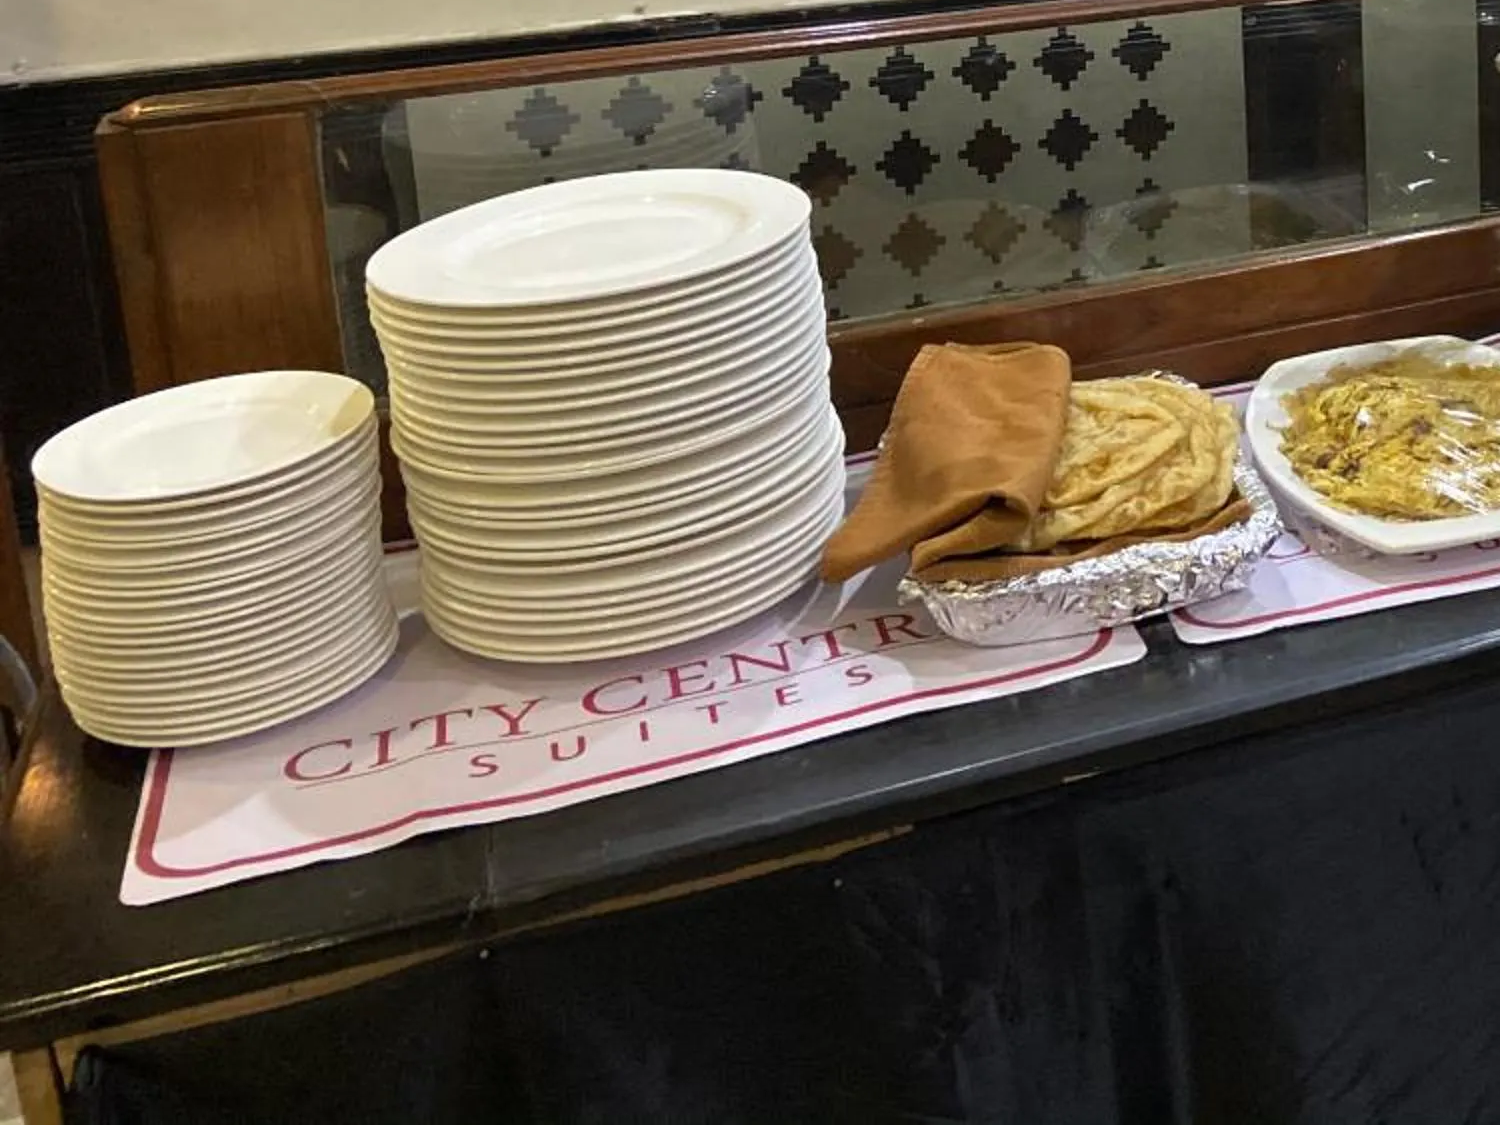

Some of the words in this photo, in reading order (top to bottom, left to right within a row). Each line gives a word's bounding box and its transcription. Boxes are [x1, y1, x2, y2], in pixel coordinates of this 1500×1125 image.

[284, 696, 548, 781] CITY
[582, 614, 934, 715] CENTR
[469, 664, 874, 777] SUITES
